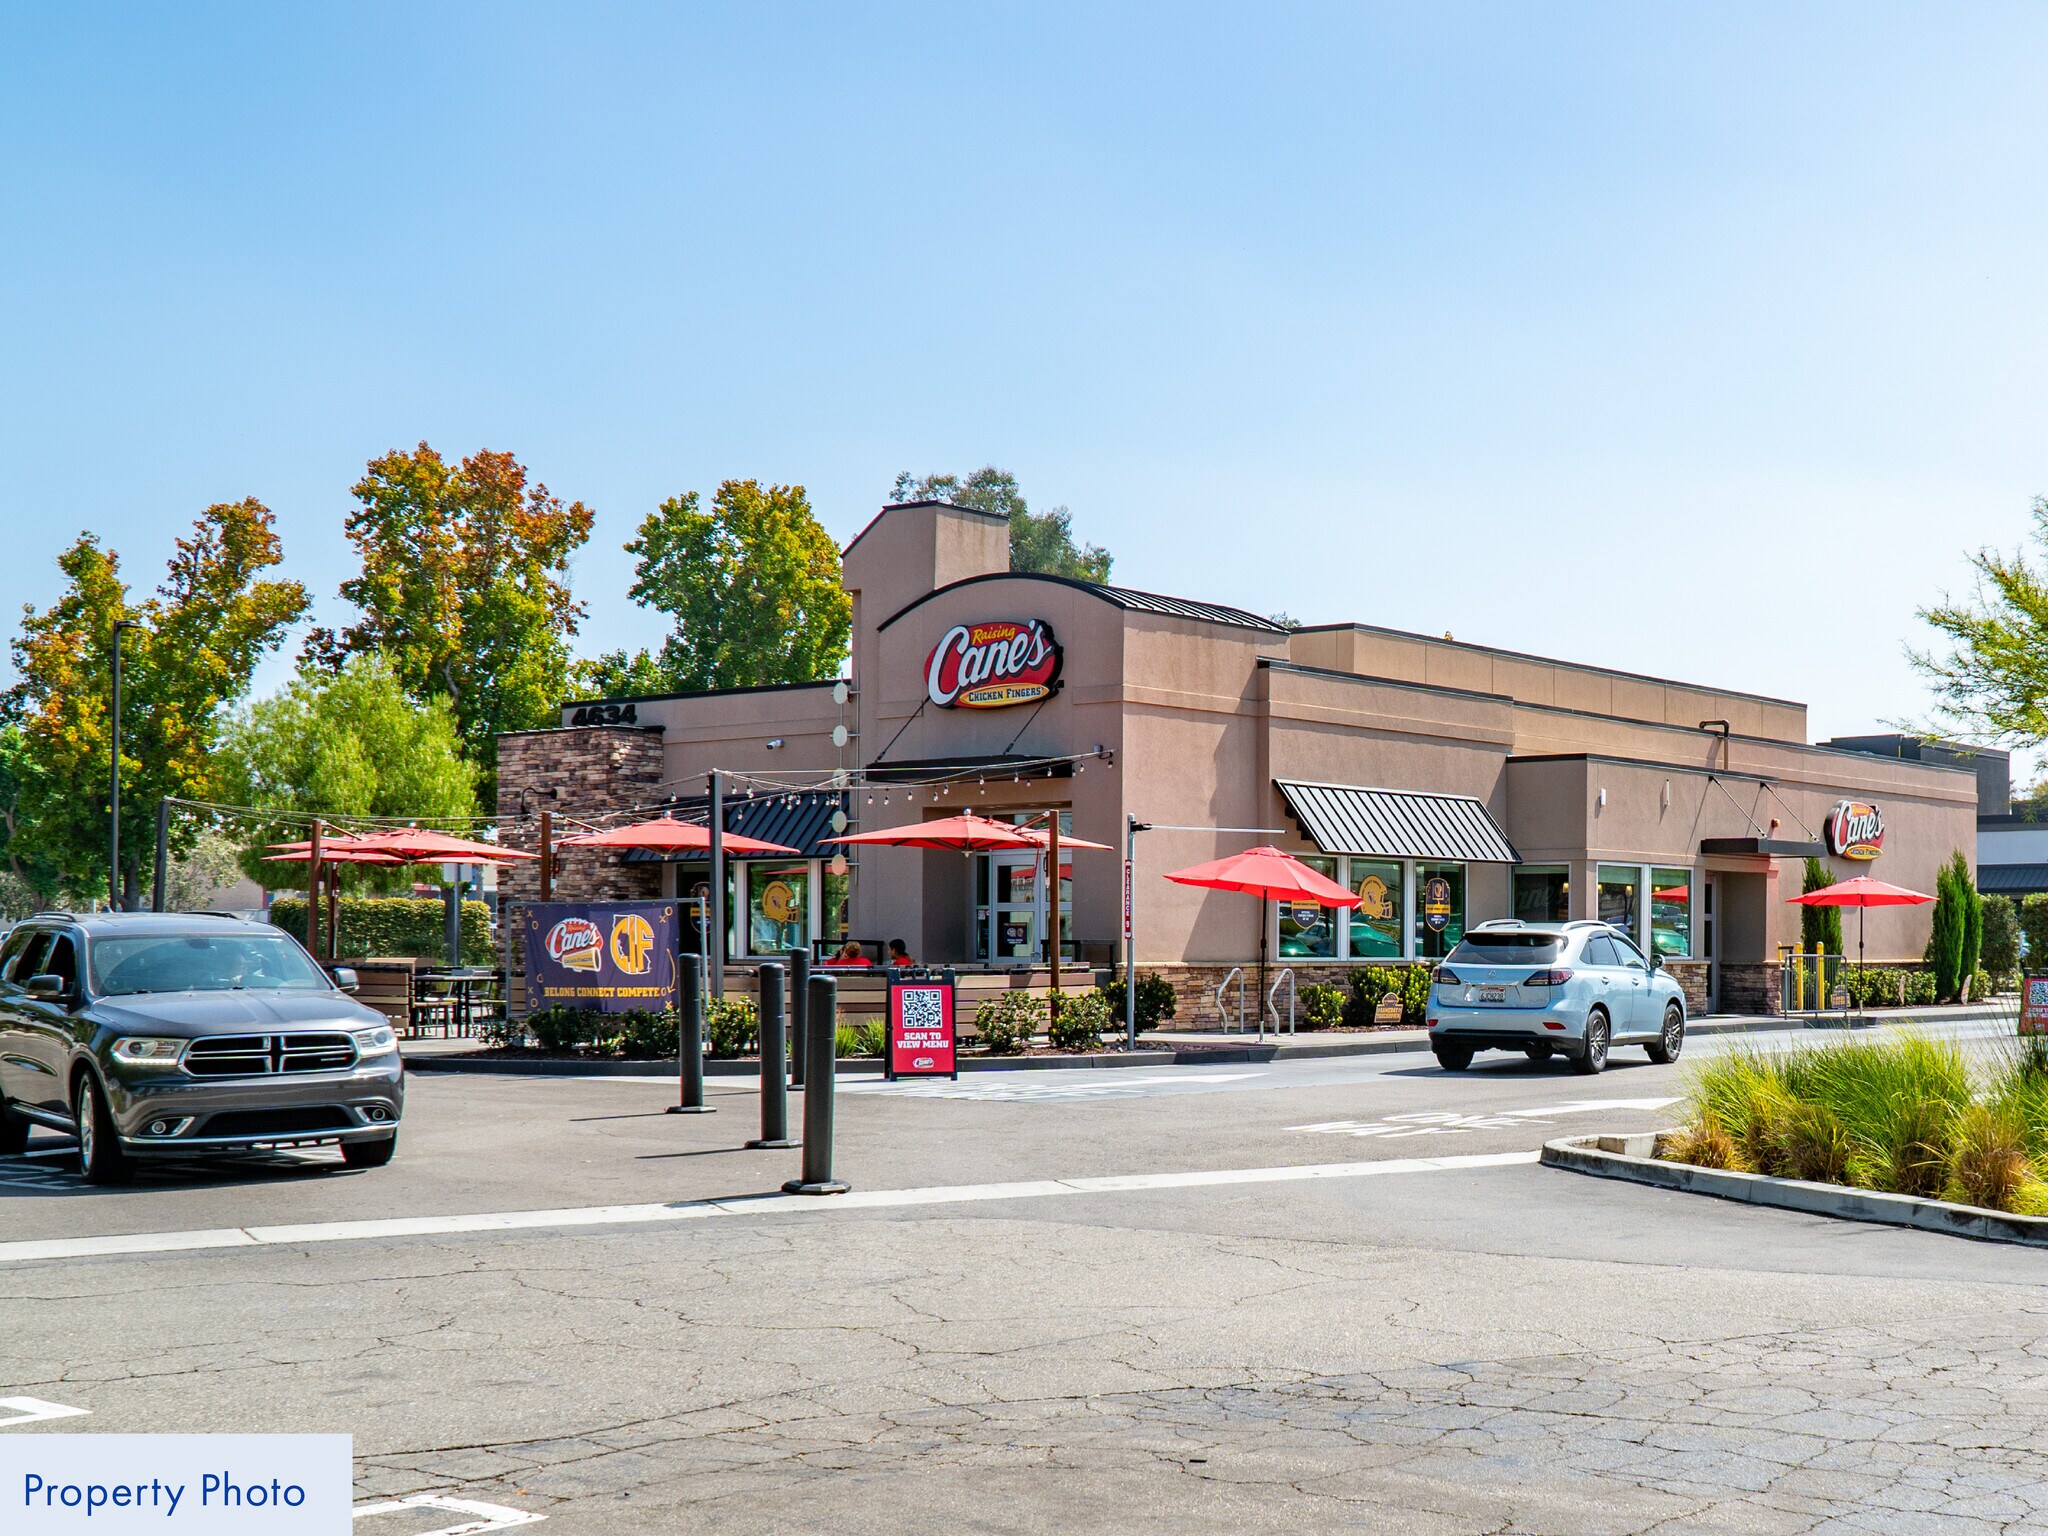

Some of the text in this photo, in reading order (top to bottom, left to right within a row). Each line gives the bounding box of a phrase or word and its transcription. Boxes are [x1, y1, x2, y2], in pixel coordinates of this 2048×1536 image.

[972, 625, 1016, 645] Raising
[928, 620, 1053, 705] Cane's
[968, 687, 1042, 702] CHICKEN FINGERS
[571, 704, 638, 726] 4634
[1834, 800, 1885, 854] Cane's
[550, 914, 655, 975] Cane's CIF
[543, 986, 660, 998] BELONG CONNECT COMPETE
[896, 1040, 949, 1049] VIEW MENU
[904, 1032, 941, 1040] SCAN TO
